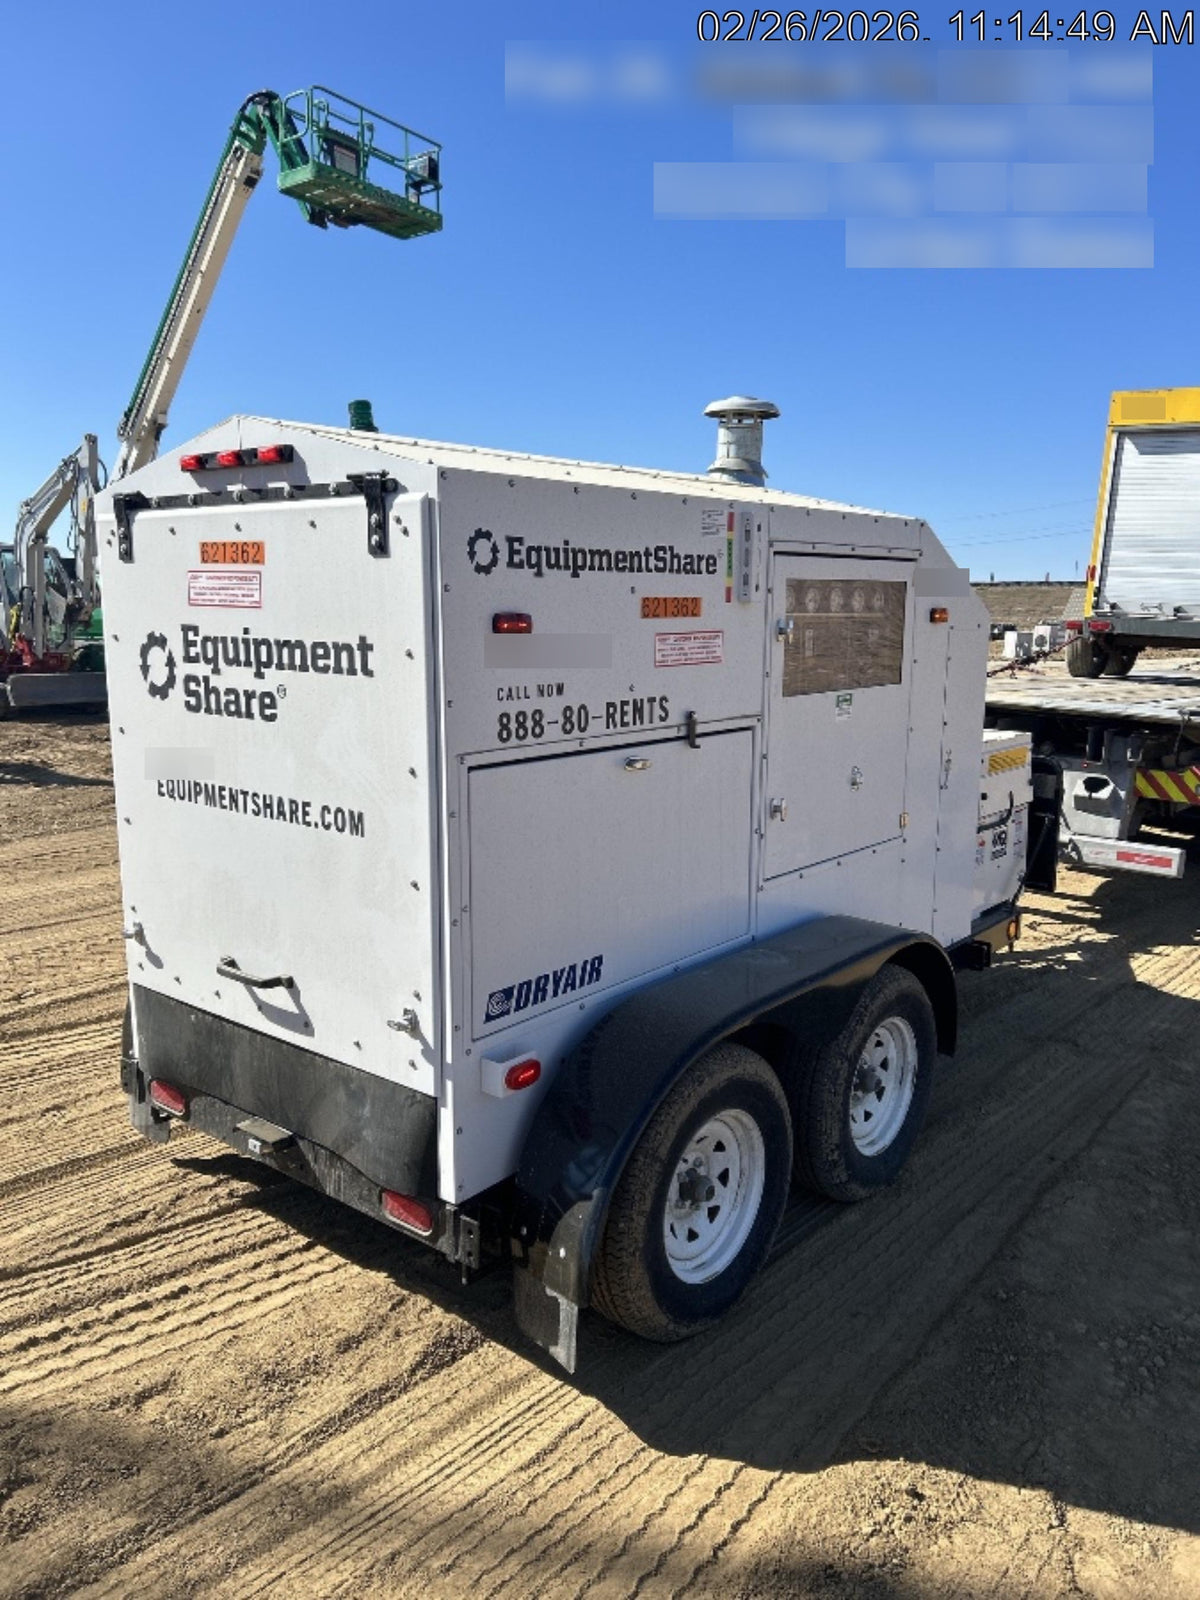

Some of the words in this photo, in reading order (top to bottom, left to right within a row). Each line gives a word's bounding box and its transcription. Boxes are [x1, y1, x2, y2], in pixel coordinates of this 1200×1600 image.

[200, 542, 261, 564] 621362
[641, 597, 699, 618] 621362
[180, 623, 374, 680] Equipment
[497, 686, 531, 701] CALL
[536, 682, 565, 698] NOW
[497, 695, 670, 743] 888-80-RENTS
[157, 779, 365, 838] EQUIPMENTSHARE.COM
[513, 954, 603, 1013] DRYAIR
